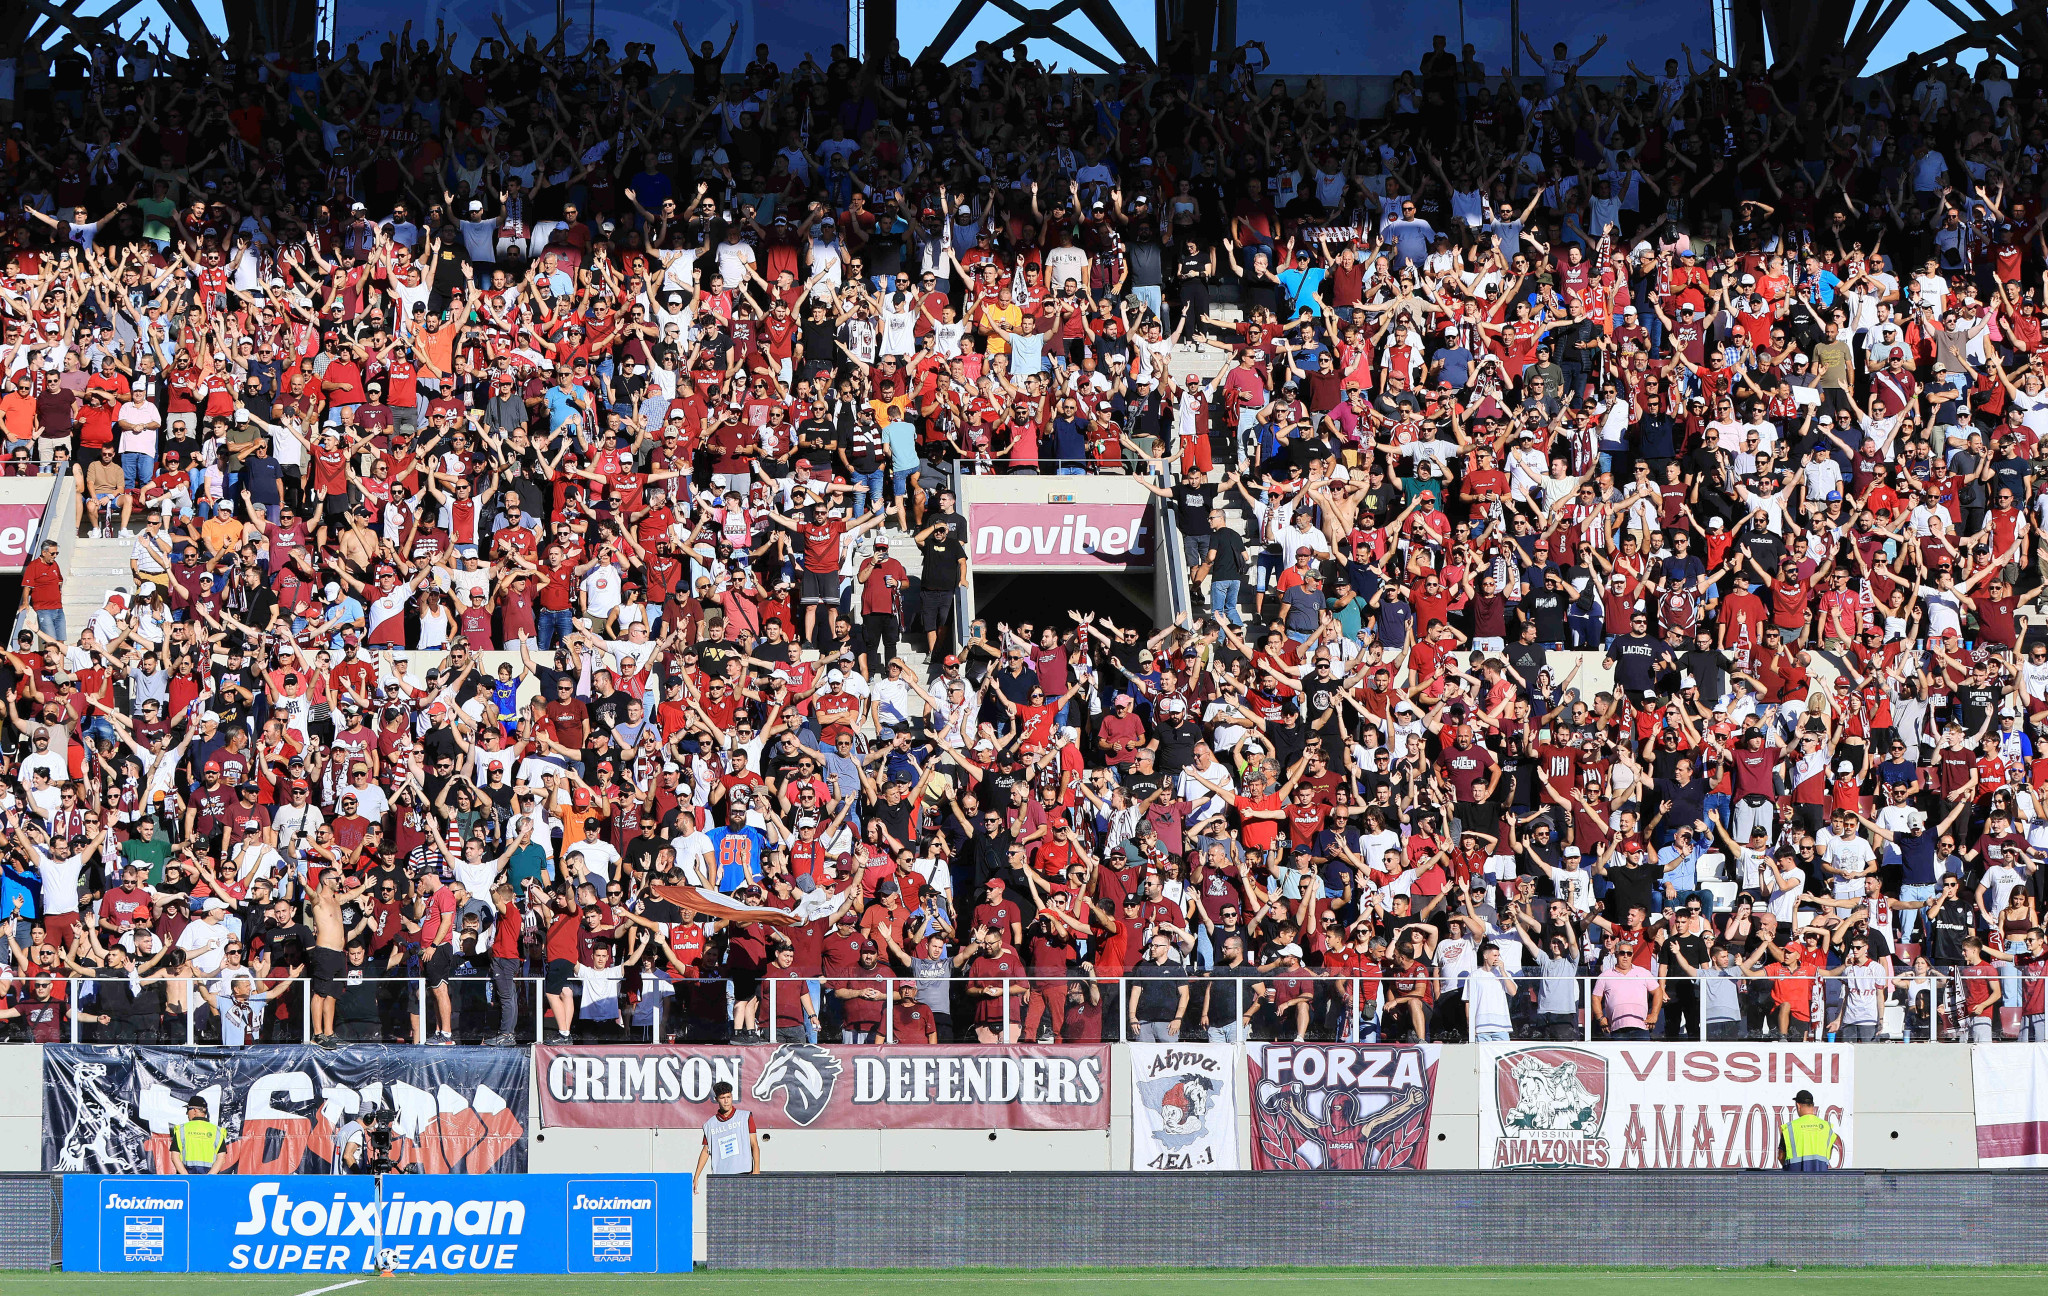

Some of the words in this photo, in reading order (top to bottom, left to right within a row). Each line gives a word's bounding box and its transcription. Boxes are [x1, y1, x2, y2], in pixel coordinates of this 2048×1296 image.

[809, 534, 830, 542] novibet
[975, 514, 1147, 555] novibet
[1622, 645, 1652, 657] LACOSTE
[497, 690, 511, 699] CR7
[826, 706, 848, 714] novibet
[223, 760, 243, 769] HISTORY
[1452, 759, 1477, 768] QUEEN
[1294, 816, 1319, 824] novibet
[719, 838, 752, 865] 88
[673, 942, 699, 951] novibet
[1266, 1048, 1424, 1089] FORZA
[1620, 1050, 1840, 1084] VISSINI
[549, 1056, 741, 1101] CRIMSON
[854, 1057, 1100, 1103] DEFENDERS
[711, 1125, 727, 1135] BALL
[727, 1120, 741, 1129] BOY
[1529, 1130, 1574, 1138] VISSINI
[1620, 1103, 1845, 1169] AMAZONS
[1328, 1142, 1354, 1150] LARISSA
[1496, 1139, 1608, 1167] AMAZONES
[1147, 1152, 1193, 1170] ΑΕΛ
[105, 1193, 184, 1210] Stoiximan
[235, 1182, 526, 1236] Stoiximan
[572, 1194, 652, 1210] Stoiximan
[228, 1244, 350, 1270] SUPER
[363, 1244, 518, 1270] LEAGUE
